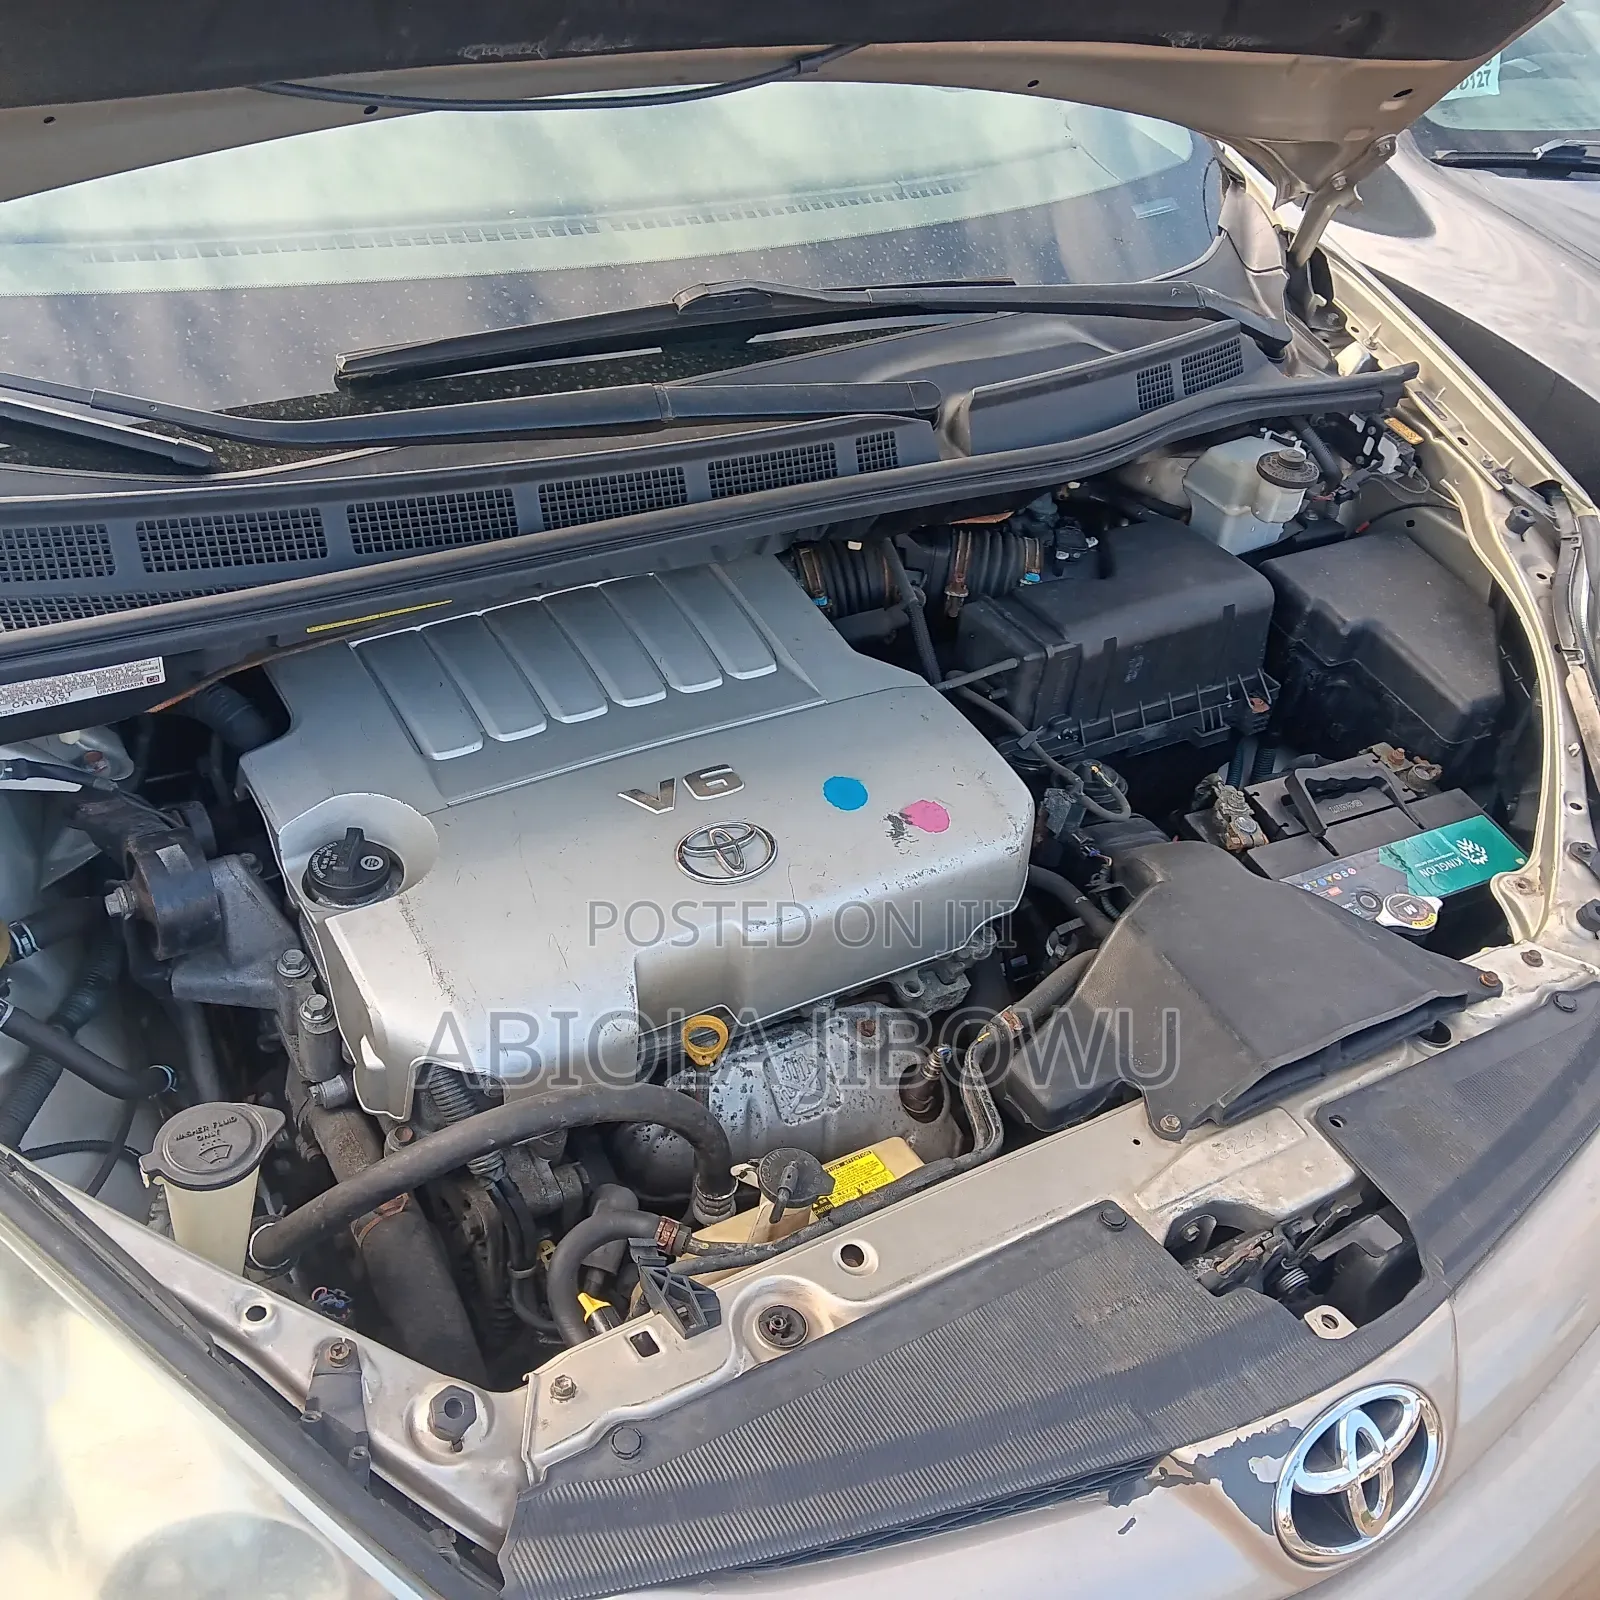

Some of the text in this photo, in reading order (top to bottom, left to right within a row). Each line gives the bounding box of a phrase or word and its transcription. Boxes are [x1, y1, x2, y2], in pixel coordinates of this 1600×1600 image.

[12, 691, 72, 709] CATALYST
[616, 763, 746, 815] V6
[1418, 858, 1465, 878] KINGLION
[175, 1116, 238, 1141] WASHER FLUID
[196, 1129, 220, 1142] ONLY
